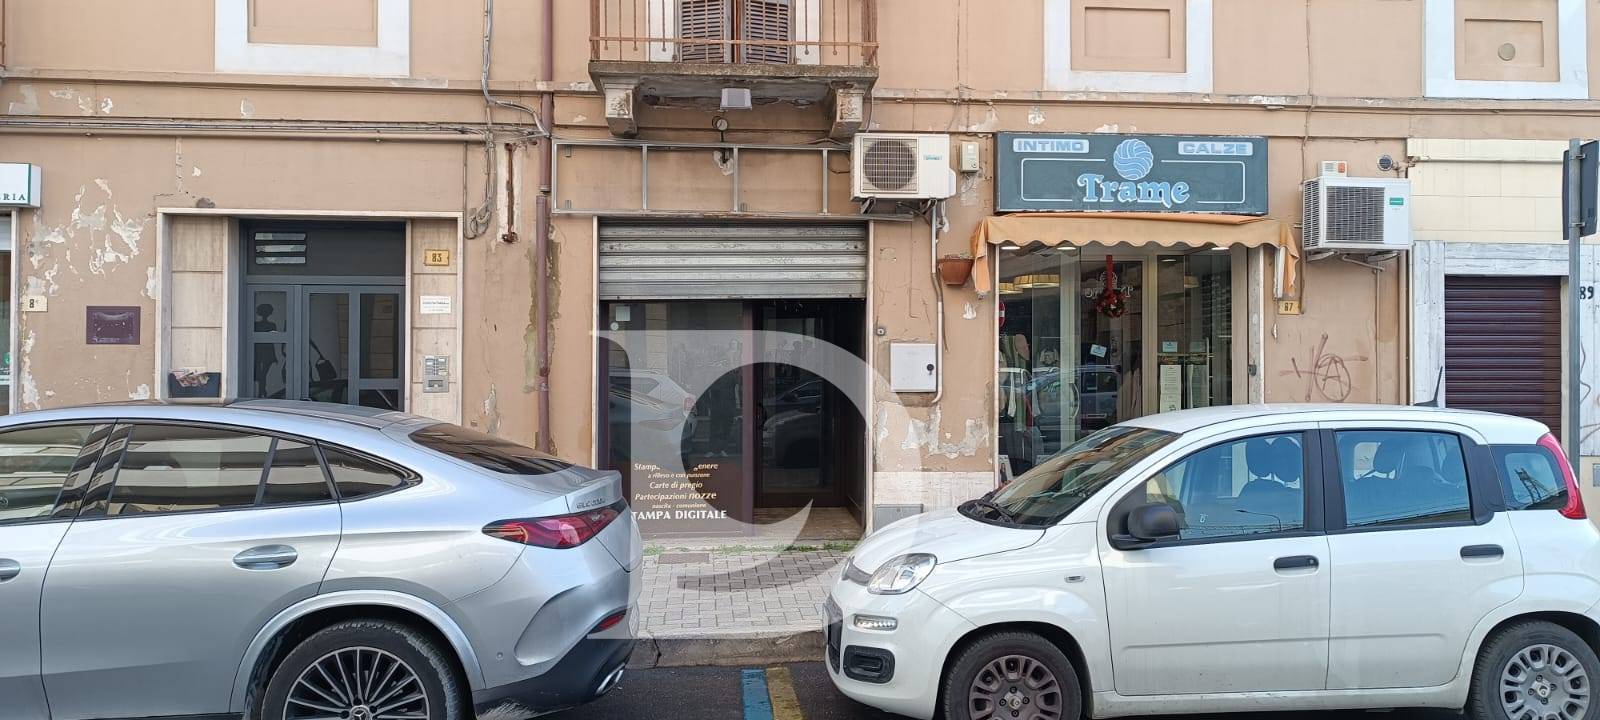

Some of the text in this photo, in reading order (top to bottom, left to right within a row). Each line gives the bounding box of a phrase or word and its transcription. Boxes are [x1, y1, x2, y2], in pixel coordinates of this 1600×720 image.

[1017, 140, 1084, 152] INTIMO
[1182, 143, 1249, 154] CALZE
[1076, 173, 1191, 208] Trame
[0, 193, 26, 201] RIA
[431, 252, 442, 263] 83
[1580, 286, 1594, 300] 89
[633, 463, 661, 472] Stamp
[649, 481, 703, 491] Carte di pregio
[634, 491, 718, 502] Partecipazioni nozze
[631, 510, 729, 520] TAMPA DIGITALE
